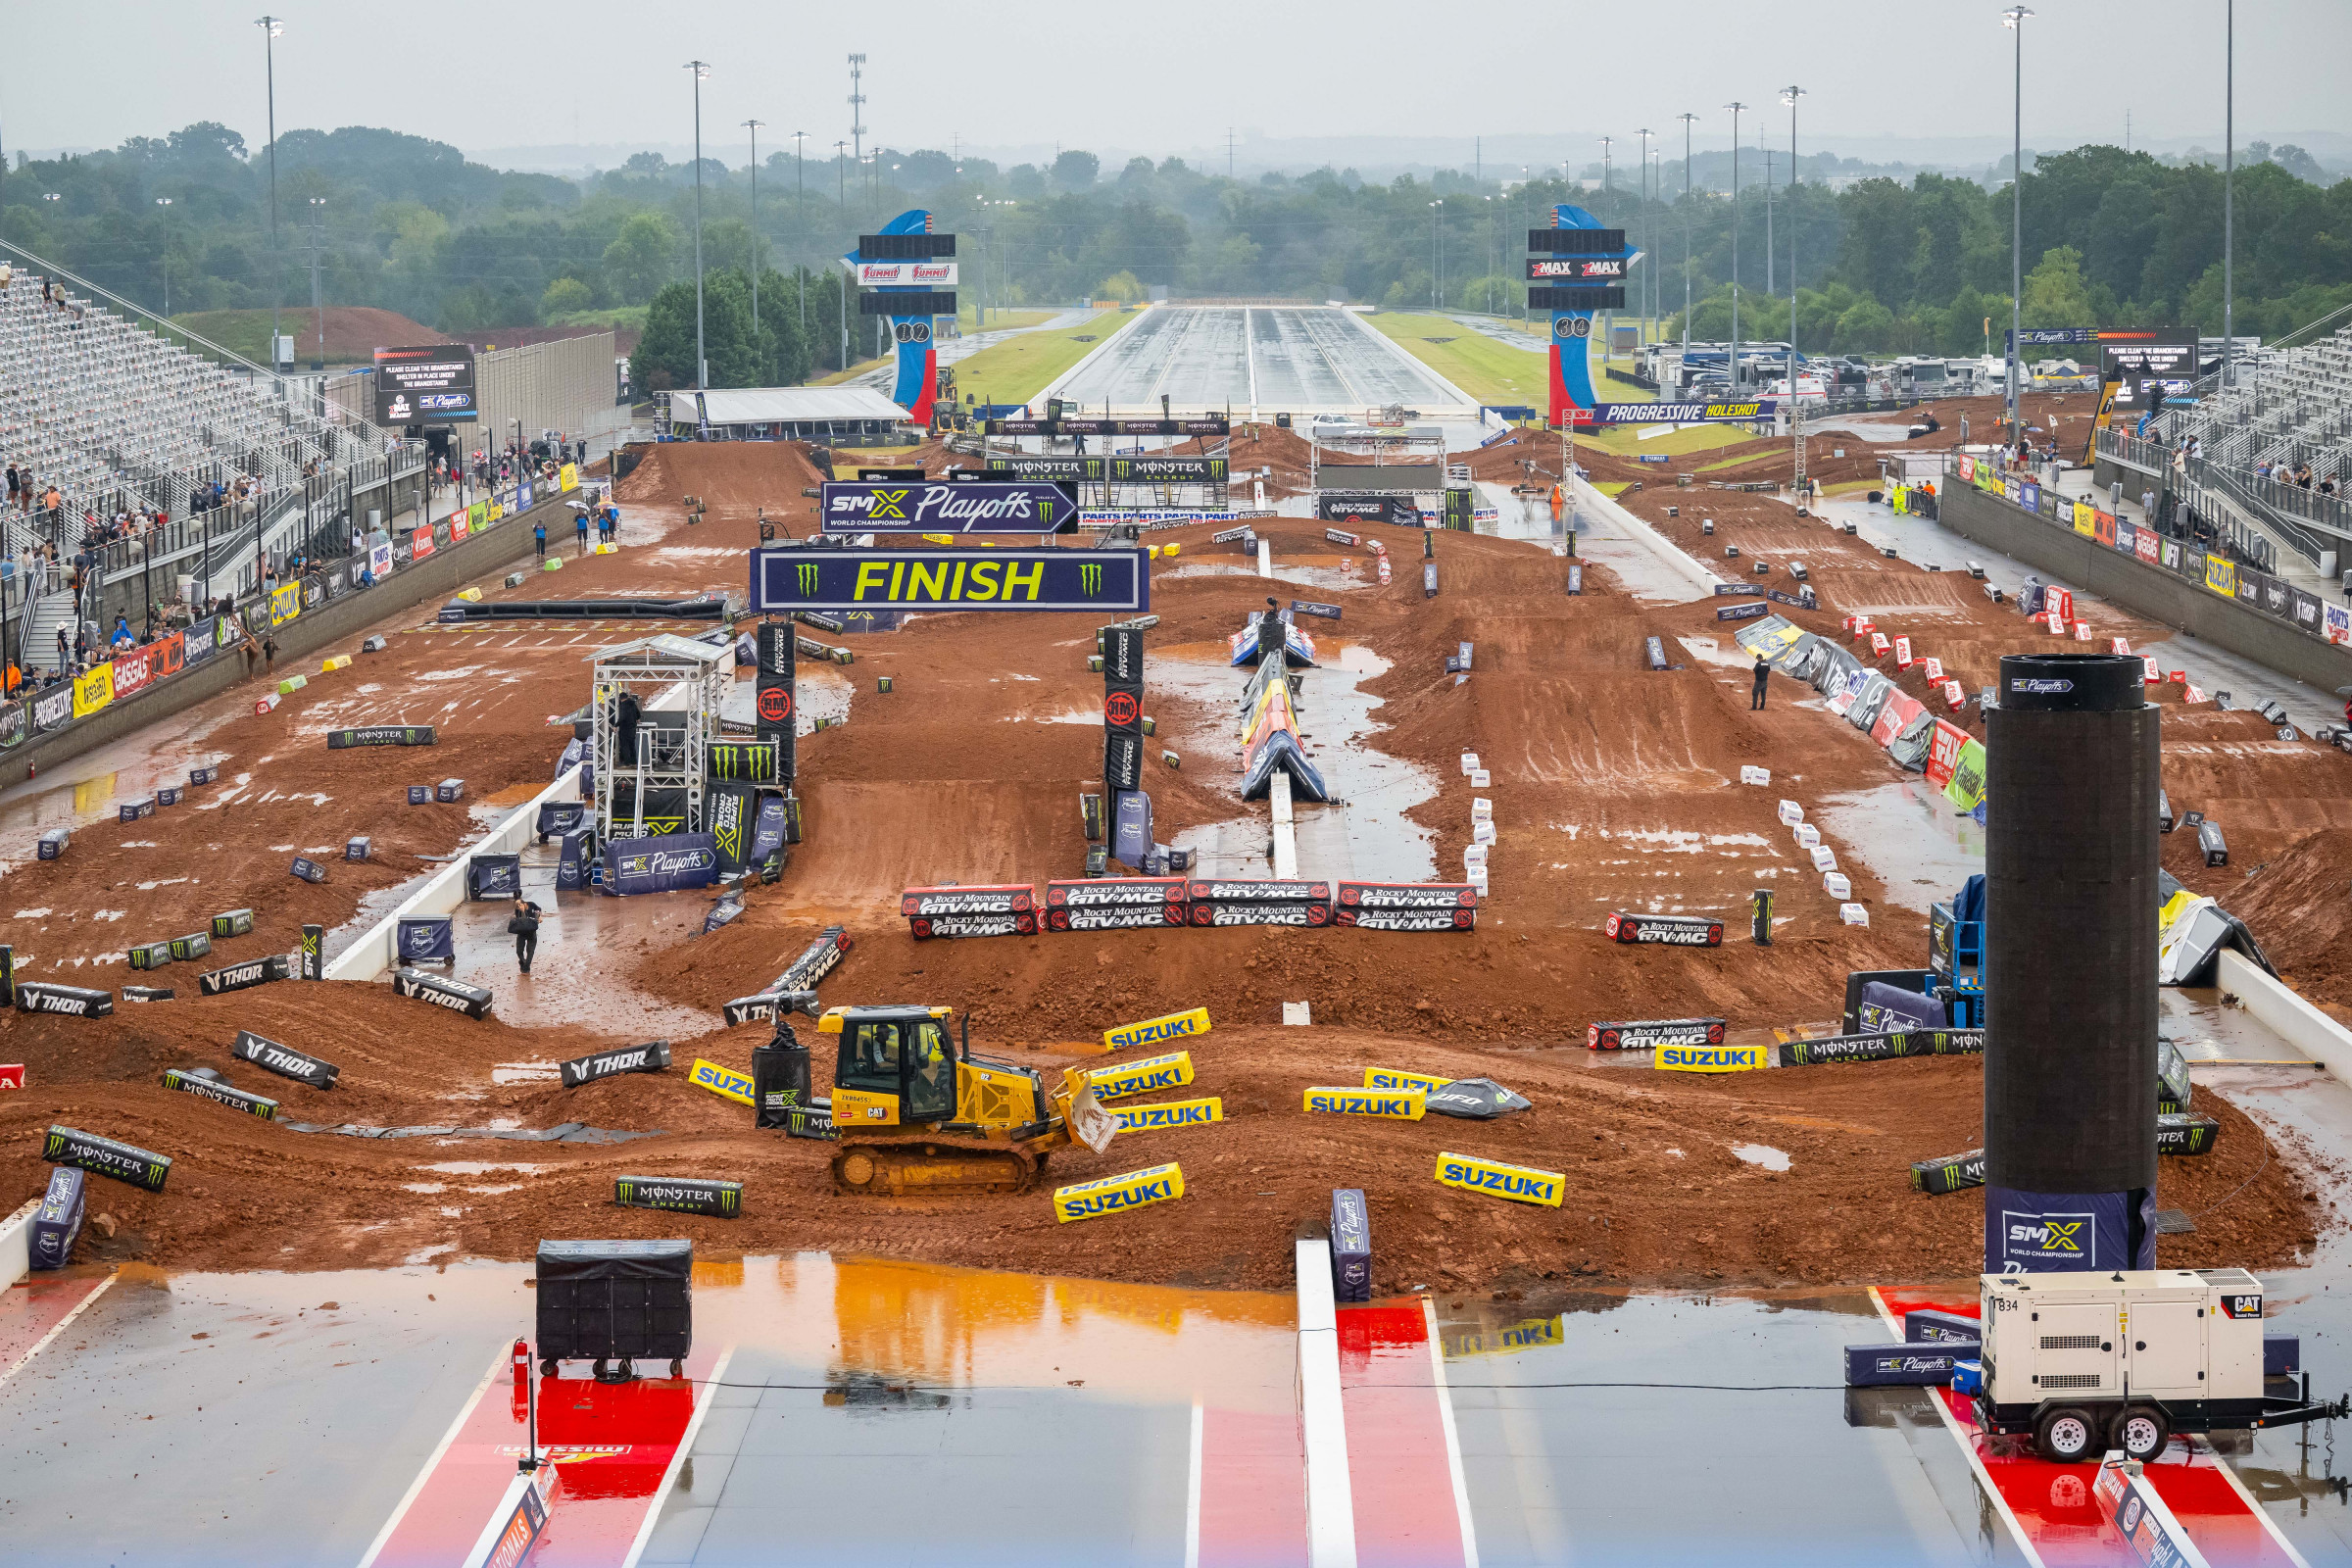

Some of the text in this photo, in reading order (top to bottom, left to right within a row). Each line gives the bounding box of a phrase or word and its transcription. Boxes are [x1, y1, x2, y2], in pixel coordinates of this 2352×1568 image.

[435, 395, 463, 409] Playoffs
[1605, 403, 1761, 420] PROGRESSIVE HOLESHOT
[1011, 461, 1080, 473] MONSTER
[1135, 462, 1204, 474] MONSTER
[830, 489, 909, 518] SMX
[914, 486, 1032, 532] Playoffs
[853, 562, 1045, 602] FINISH
[2208, 560, 2233, 591] SUZUKI
[272, 588, 299, 620] SUZUKI
[2328, 606, 2349, 630] PARTS
[114, 656, 148, 691] GASGAS
[2028, 679, 2062, 694] Playoffs
[357, 730, 402, 740] MONSTER
[721, 722, 753, 733] MONSTER
[716, 793, 726, 827] CROSS
[723, 796, 733, 828] MOTO
[729, 794, 739, 830] SUPER
[622, 852, 702, 876] SMX Playoffs
[971, 915, 1015, 924] MOUNTAIN
[1113, 906, 1162, 915] MOUNTAIN
[1228, 906, 1305, 914] ROCKY MOUNTAIN
[1402, 909, 1452, 918] MOUNTAIN
[1650, 922, 1709, 933] ROCKY MOUNTAIN
[302, 933, 317, 977] SMX
[223, 964, 264, 985] THOR
[788, 942, 837, 992] ROCKY MOUNTAIN
[42, 995, 87, 1014] THOR
[420, 987, 469, 1012] THOR
[1110, 1018, 1195, 1049] SUZUKI
[1634, 1025, 1706, 1037] ROCKY MOUNTAIN
[1813, 1038, 1886, 1055] MONSTER
[266, 1048, 317, 1077] THOR
[593, 1051, 646, 1074] THOR
[1663, 1051, 1755, 1065] SUZUKI
[1092, 1068, 1182, 1101] SUZUKI
[183, 1082, 249, 1112] MONSTER
[1310, 1096, 1410, 1115] SUZUKI
[1437, 1094, 1483, 1106] UFO
[867, 1107, 883, 1118] CAT
[1116, 1104, 1211, 1130] SUZUKI
[70, 1143, 142, 1173] MONSTER
[78, 1158, 128, 1177] ENERGY
[1444, 1163, 1553, 1200] SUZUKI
[640, 1185, 713, 1203] MONSTER
[1064, 1180, 1172, 1217] SUZUKI
[651, 1200, 703, 1209] ENERGY
[2009, 1222, 2082, 1250] SMX
[1999, 1300, 2018, 1312] 834
[2234, 1296, 2260, 1312] CAT
[1903, 1356, 1946, 1374] Playoffs
